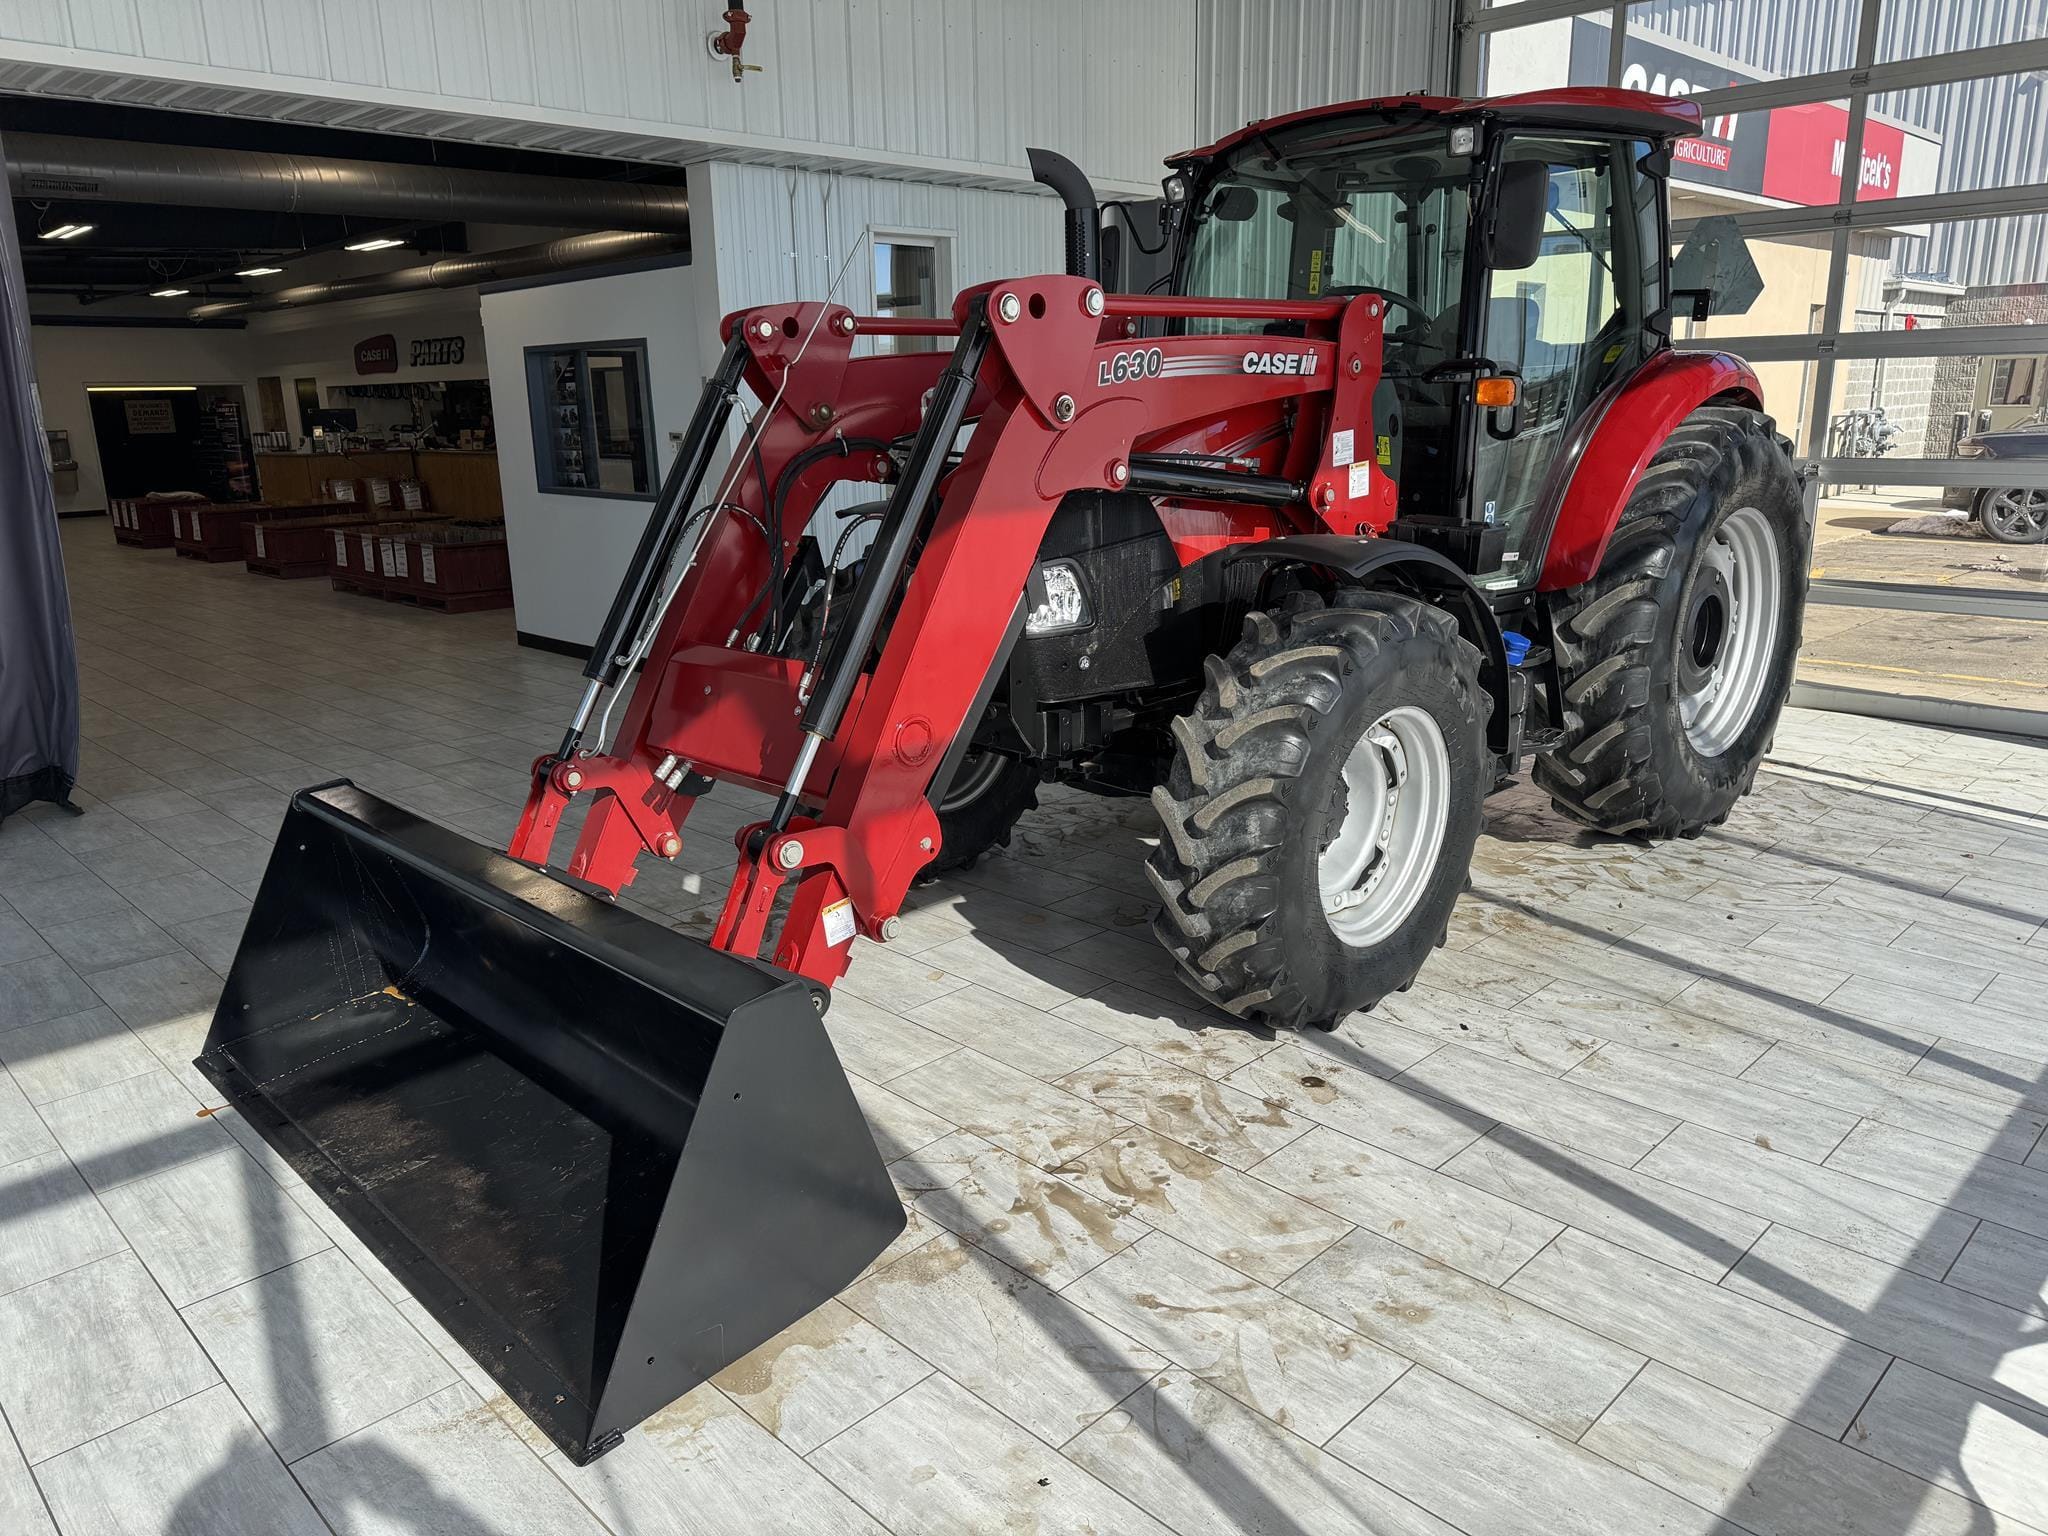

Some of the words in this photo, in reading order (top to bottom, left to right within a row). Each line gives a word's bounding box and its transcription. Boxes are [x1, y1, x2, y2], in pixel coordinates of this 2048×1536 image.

[1674, 139, 1726, 166] GRICULTURE
[410, 336, 465, 367] PARTS
[1098, 347, 1163, 387] L630
[1242, 351, 1298, 375] CASE
